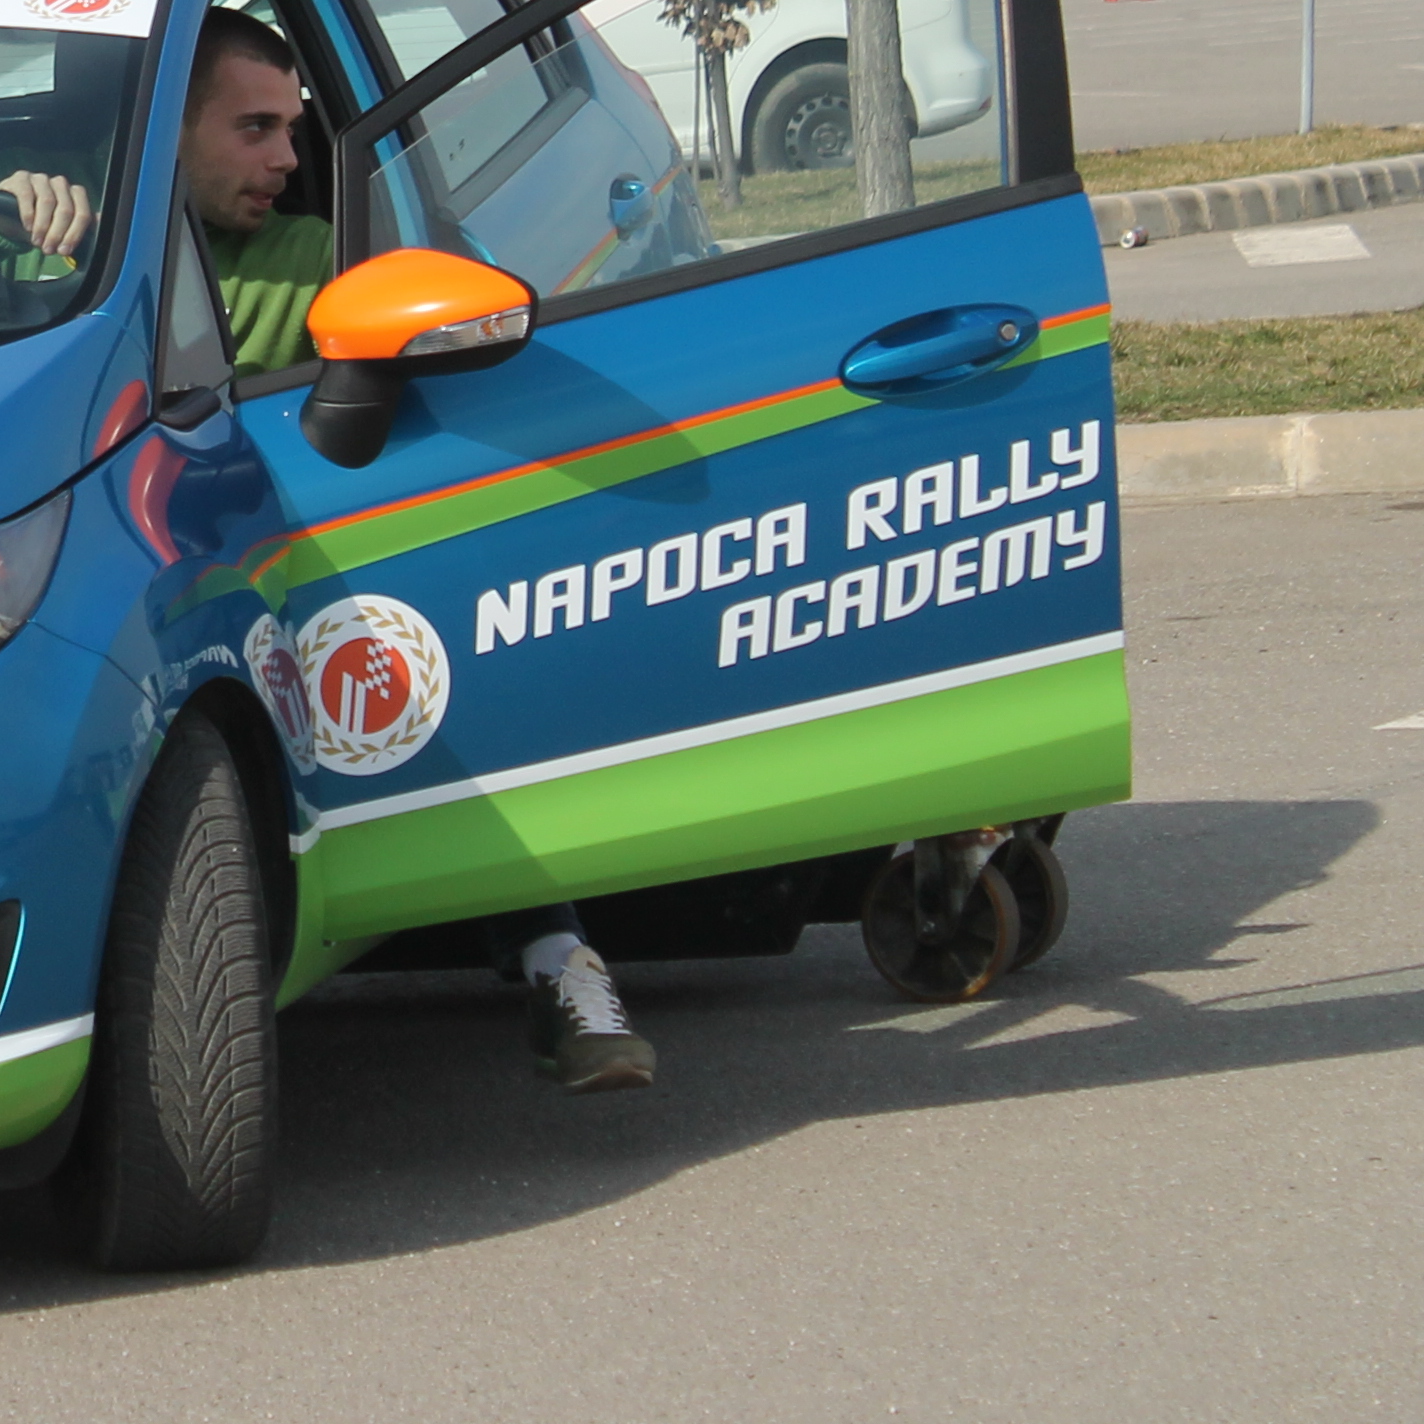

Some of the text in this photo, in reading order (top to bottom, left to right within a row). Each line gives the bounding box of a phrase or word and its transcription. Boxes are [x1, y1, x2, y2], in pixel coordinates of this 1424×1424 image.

[475, 420, 1101, 654] NAPOCA RALLY
[718, 501, 1107, 668] ACADEMY
